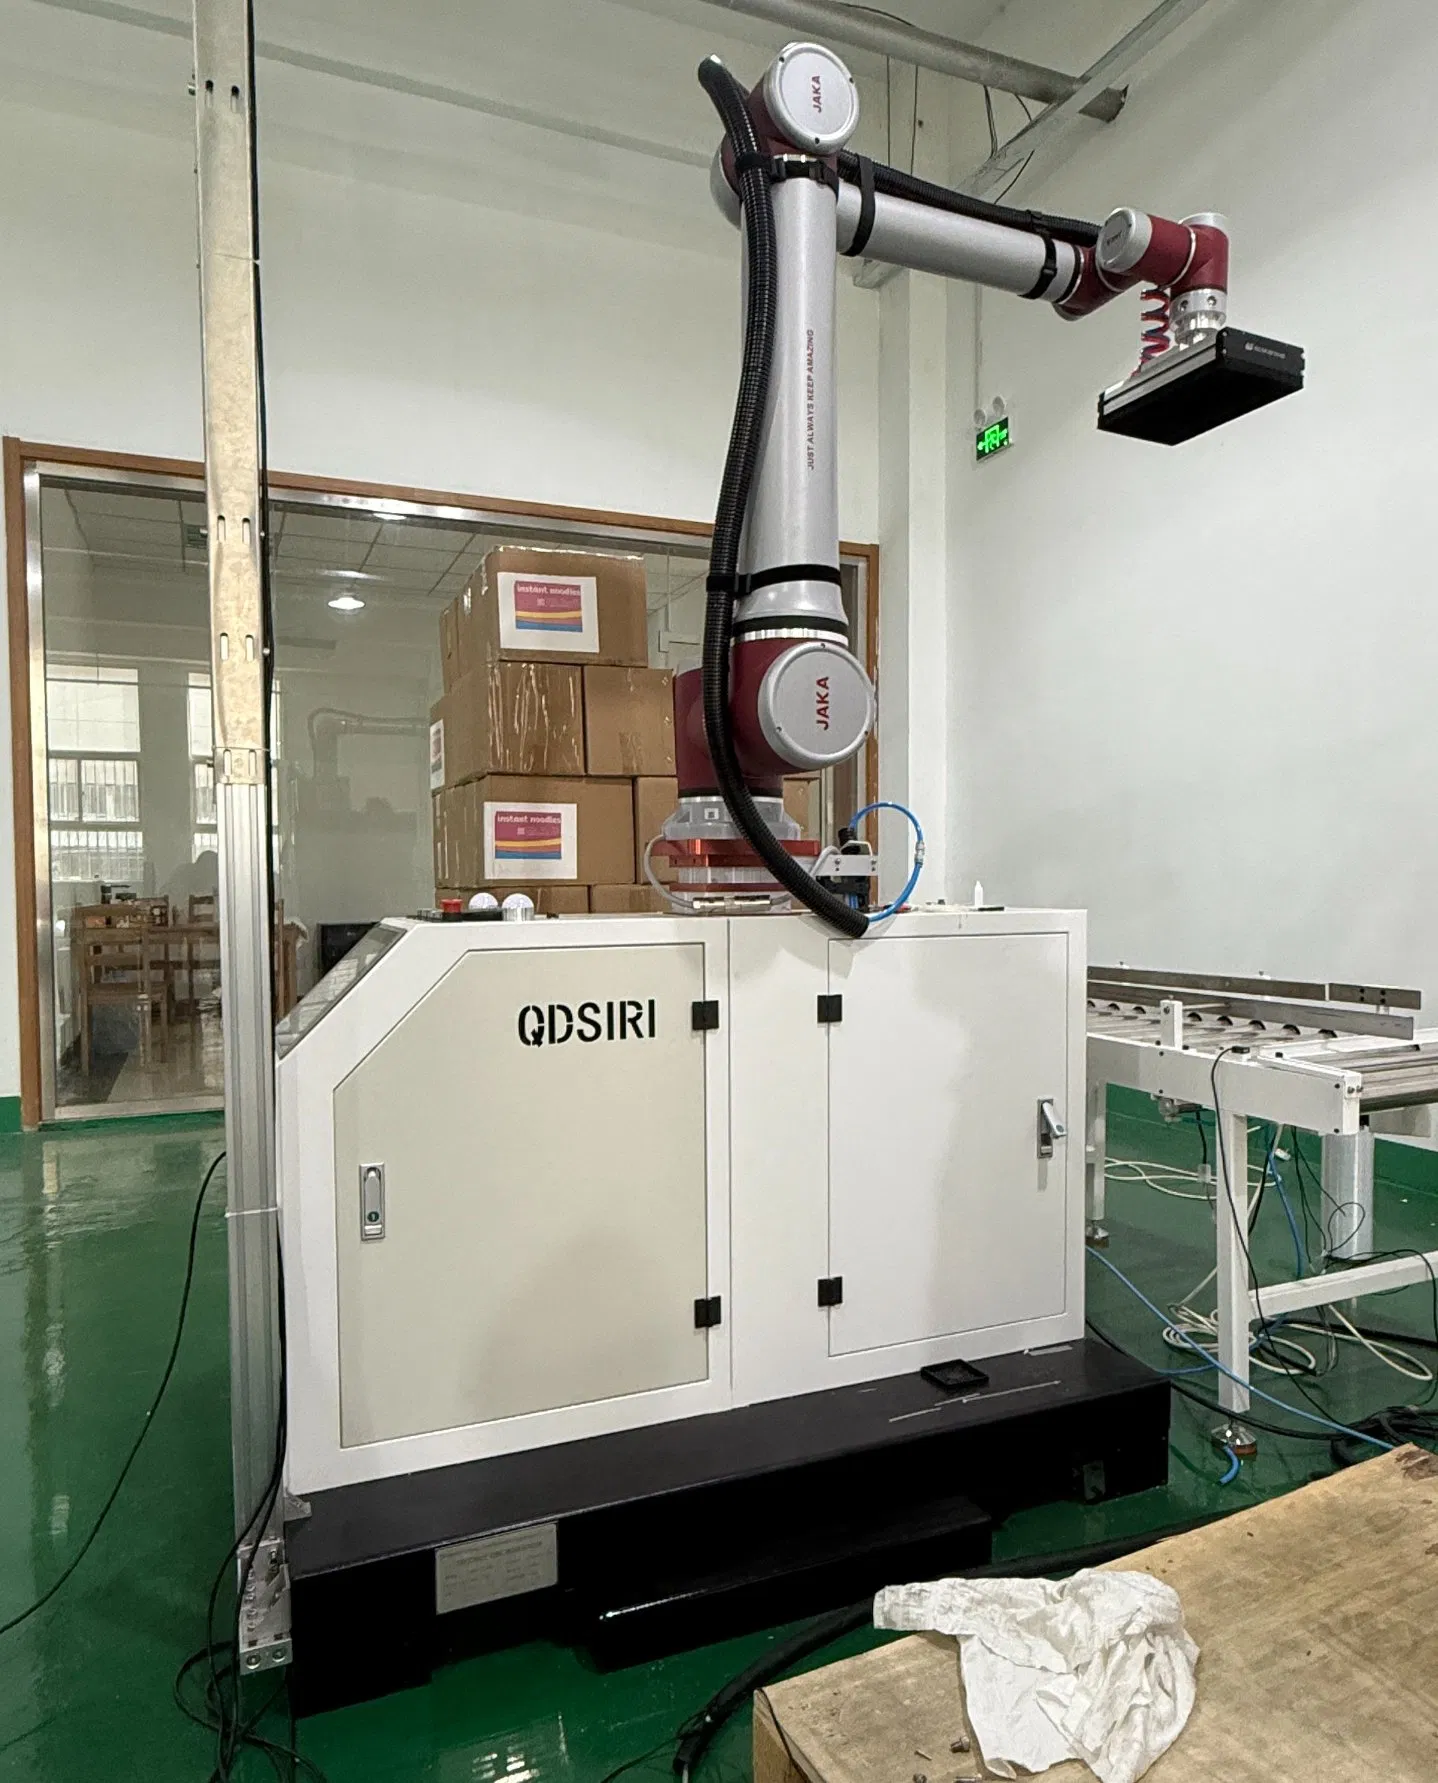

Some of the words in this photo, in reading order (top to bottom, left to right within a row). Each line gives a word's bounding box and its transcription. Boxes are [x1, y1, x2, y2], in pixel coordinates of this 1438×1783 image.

[811, 75, 822, 114] JAKA
[806, 329, 814, 374] AMAZING
[806, 375, 814, 401] KEEP
[806, 403, 815, 444] ALWAYS
[806, 446, 815, 470] JUST
[815, 676, 829, 731] JAKA
[497, 813, 529, 823] instant
[518, 999, 656, 1048] QDSIRI
